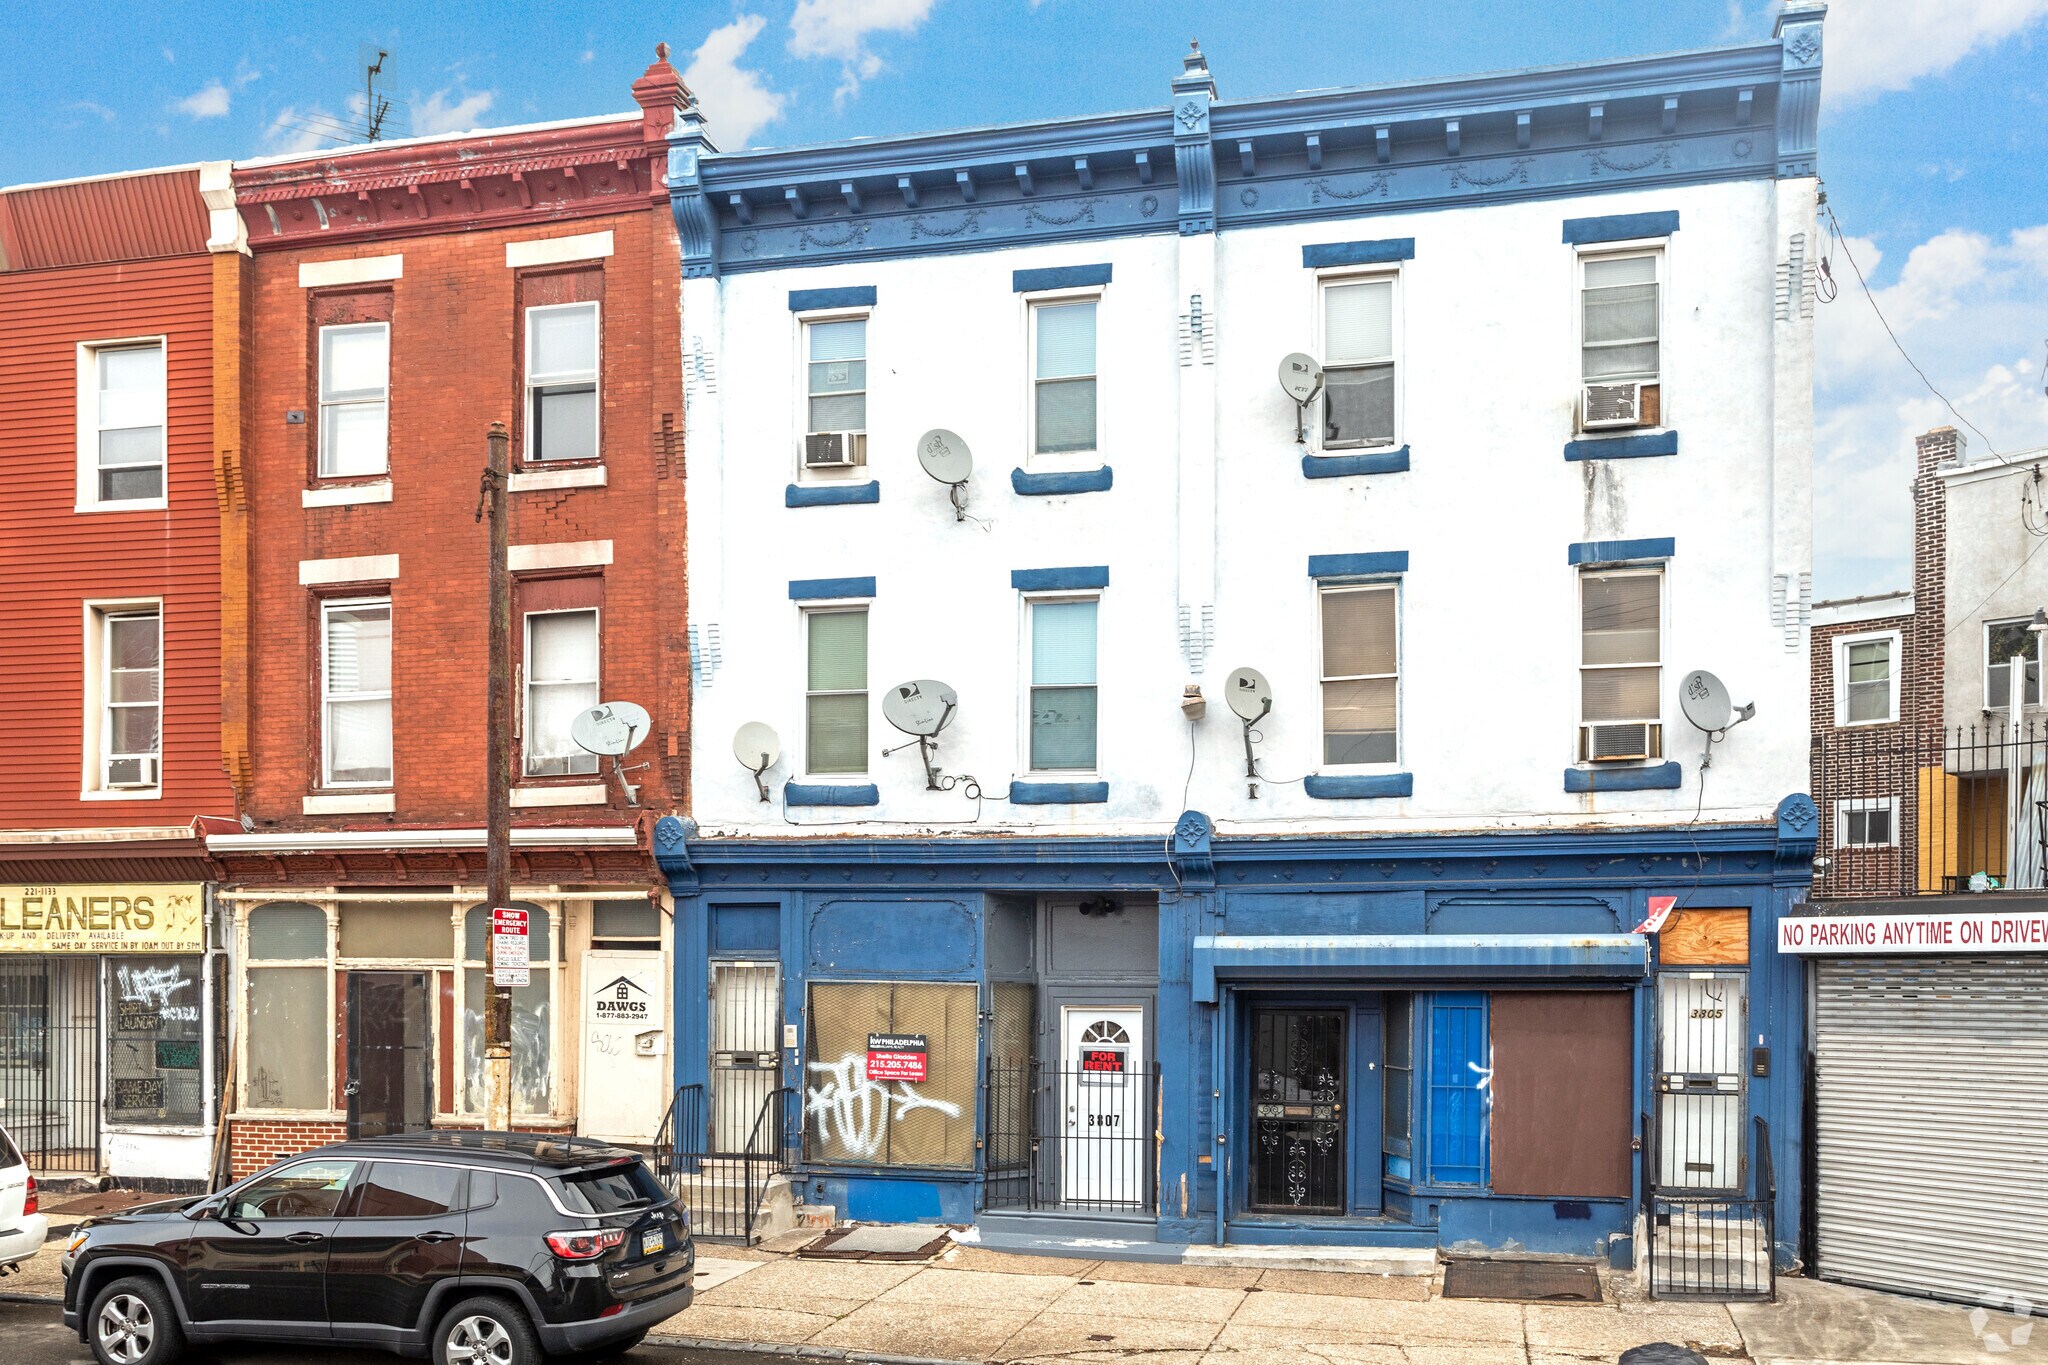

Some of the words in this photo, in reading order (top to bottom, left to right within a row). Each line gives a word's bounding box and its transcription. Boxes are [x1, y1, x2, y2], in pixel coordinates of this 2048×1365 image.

[24, 887, 57, 896] 221-1133
[502, 911, 520, 919] SNOW
[495, 919, 527, 927] EMERGENCY
[21, 931, 37, 940] AND
[46, 931, 80, 940] DELIVERY
[88, 931, 125, 940] AVAILABLE
[1783, 924, 1804, 946] NO
[1810, 922, 1876, 945] PARKING
[1882, 921, 1953, 945] ANYTIME
[1960, 920, 1983, 944] ON
[51, 941, 71, 950] SAME
[74, 941, 87, 950] DAY
[90, 941, 119, 950] SERVICE
[120, 941, 129, 950] IN
[130, 941, 139, 950] BY
[160, 941, 174, 950] OUT
[176, 941, 184, 950] BY
[186, 941, 201, 950] 5PM
[596, 1001, 646, 1012] DAWGS
[1690, 1009, 1724, 1019] 3805
[119, 1015, 160, 1030] LAUNDRY
[1091, 1051, 1116, 1061] FOR
[870, 1060, 922, 1070] 215.205.7486
[1084, 1060, 1122, 1071] RENT
[117, 1080, 142, 1094] SAME
[144, 1080, 162, 1094] DAY
[122, 1094, 158, 1108] SERVICE
[1088, 1114, 1120, 1127] 3807
